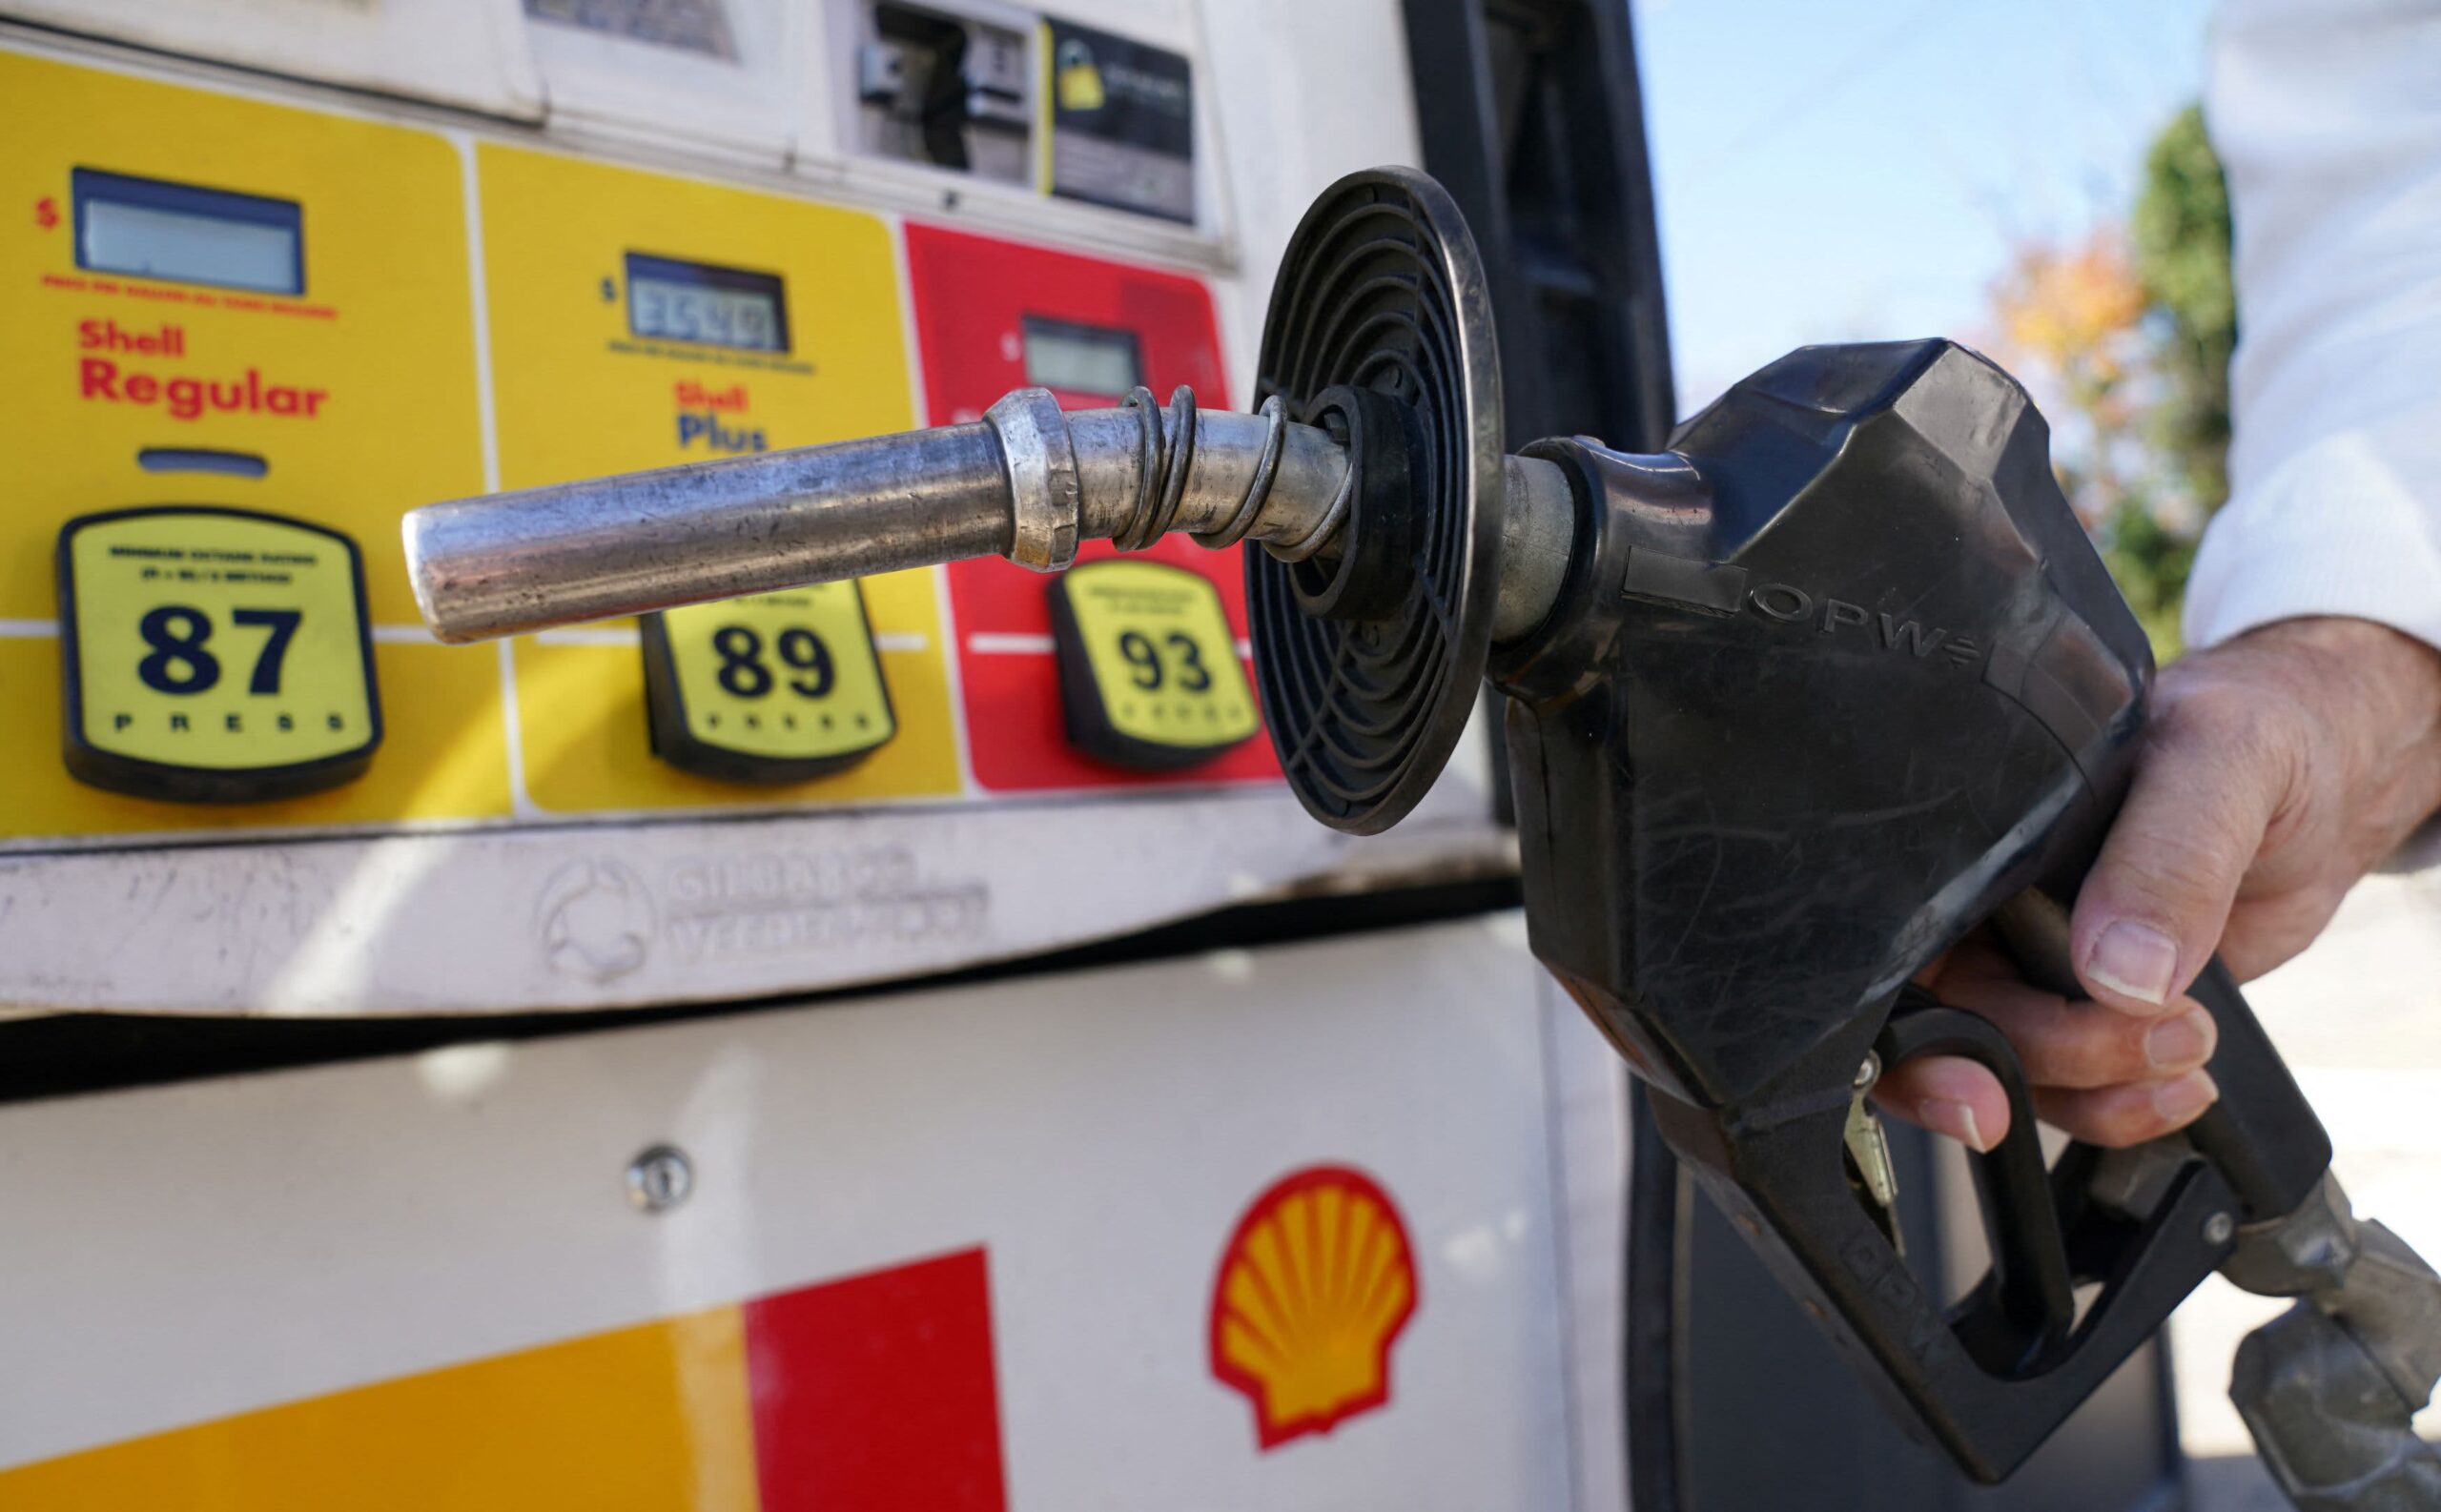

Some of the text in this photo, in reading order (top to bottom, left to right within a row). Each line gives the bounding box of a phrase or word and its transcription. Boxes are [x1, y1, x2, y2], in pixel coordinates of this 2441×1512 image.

[34, 197, 60, 230] $
[78, 317, 186, 358] Shell
[78, 357, 329, 421] Regular
[673, 380, 749, 414] Shell
[677, 412, 768, 453] Plus
[137, 604, 303, 698] 87
[1749, 582, 1948, 658] OPW
[712, 623, 836, 701] 89
[1118, 629, 1212, 694] 93
